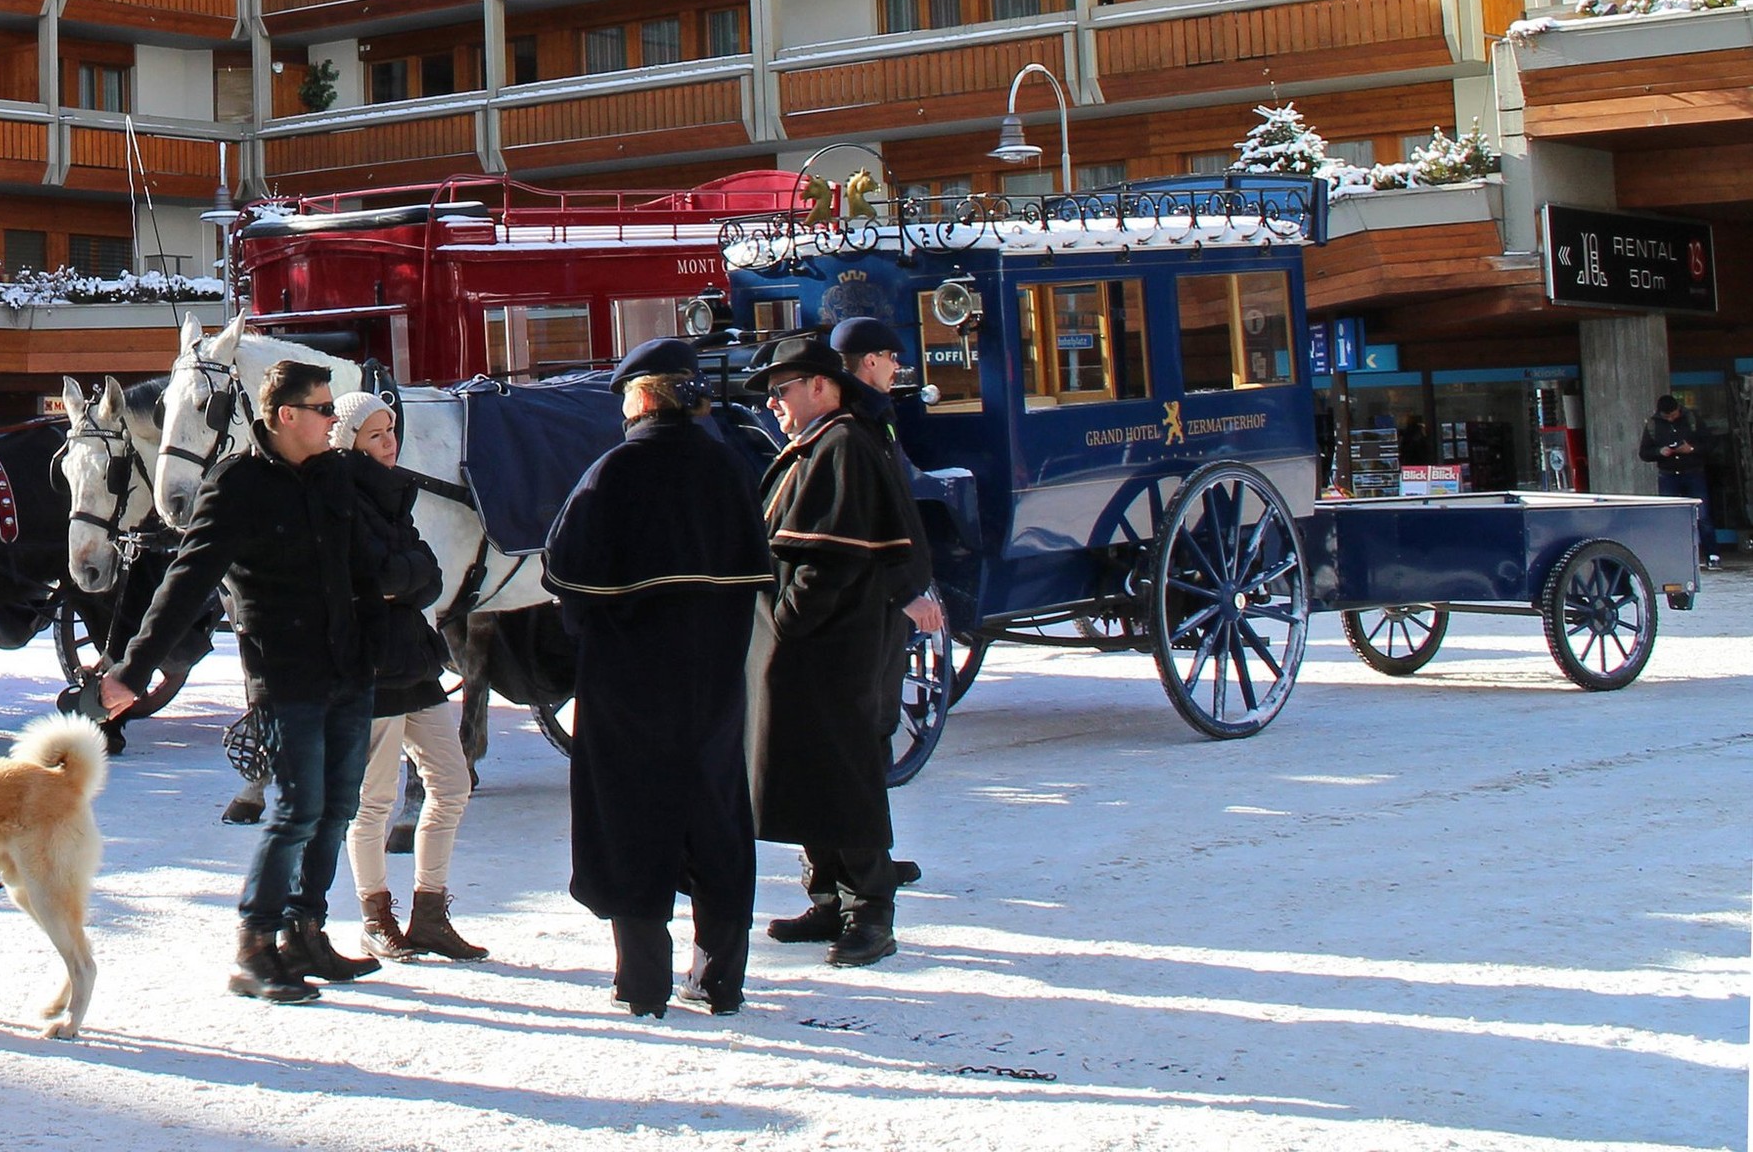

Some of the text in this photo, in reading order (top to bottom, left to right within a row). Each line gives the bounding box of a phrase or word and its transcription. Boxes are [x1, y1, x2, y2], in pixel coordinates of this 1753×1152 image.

[1612, 236, 1678, 261] RENTAL
[677, 258, 715, 274] MONT
[1629, 269, 1666, 289] 50m
[935, 350, 979, 362] OFFIE
[1085, 413, 1267, 446] GRAND HOTEL ZERMATTERHOF
[1403, 470, 1427, 480] Blick
[1432, 469, 1456, 480] Blick
